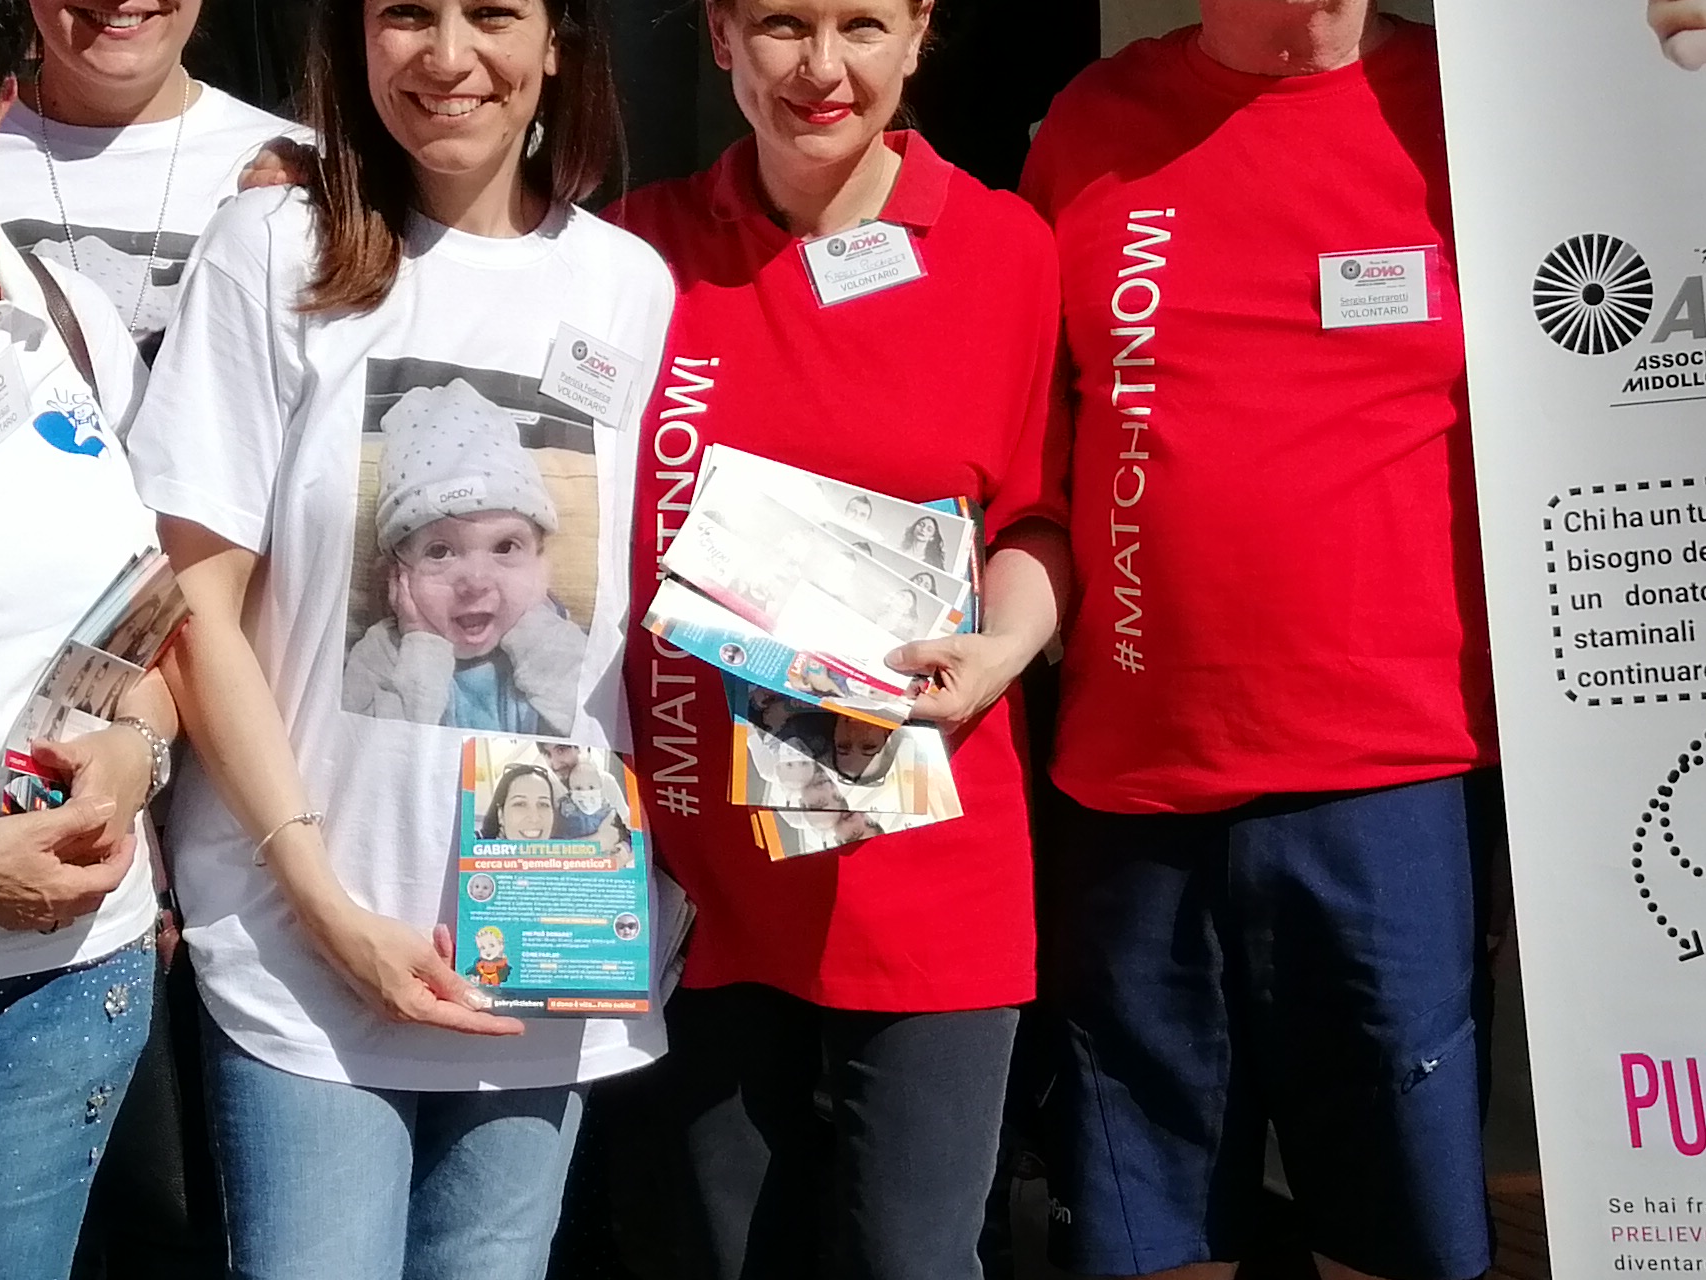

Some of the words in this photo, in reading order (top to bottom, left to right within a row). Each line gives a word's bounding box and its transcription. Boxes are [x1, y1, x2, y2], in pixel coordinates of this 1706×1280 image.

[840, 267, 899, 292] VOLONTARIO
[1341, 305, 1409, 319] VOLONTARIO
[557, 384, 607, 415] VOLONTARIO
[1110, 207, 1177, 675] #MATCHITNOW!
[1564, 508, 1606, 533] Chi
[1612, 507, 1644, 529] ha
[1650, 508, 1681, 526] un
[1567, 548, 1672, 573] bisogno
[1571, 593, 1602, 610] un
[1574, 619, 1695, 649] staminali
[473, 844, 518, 856] GABRY
[475, 860, 502, 869] cerca
[503, 860, 517, 869] un
